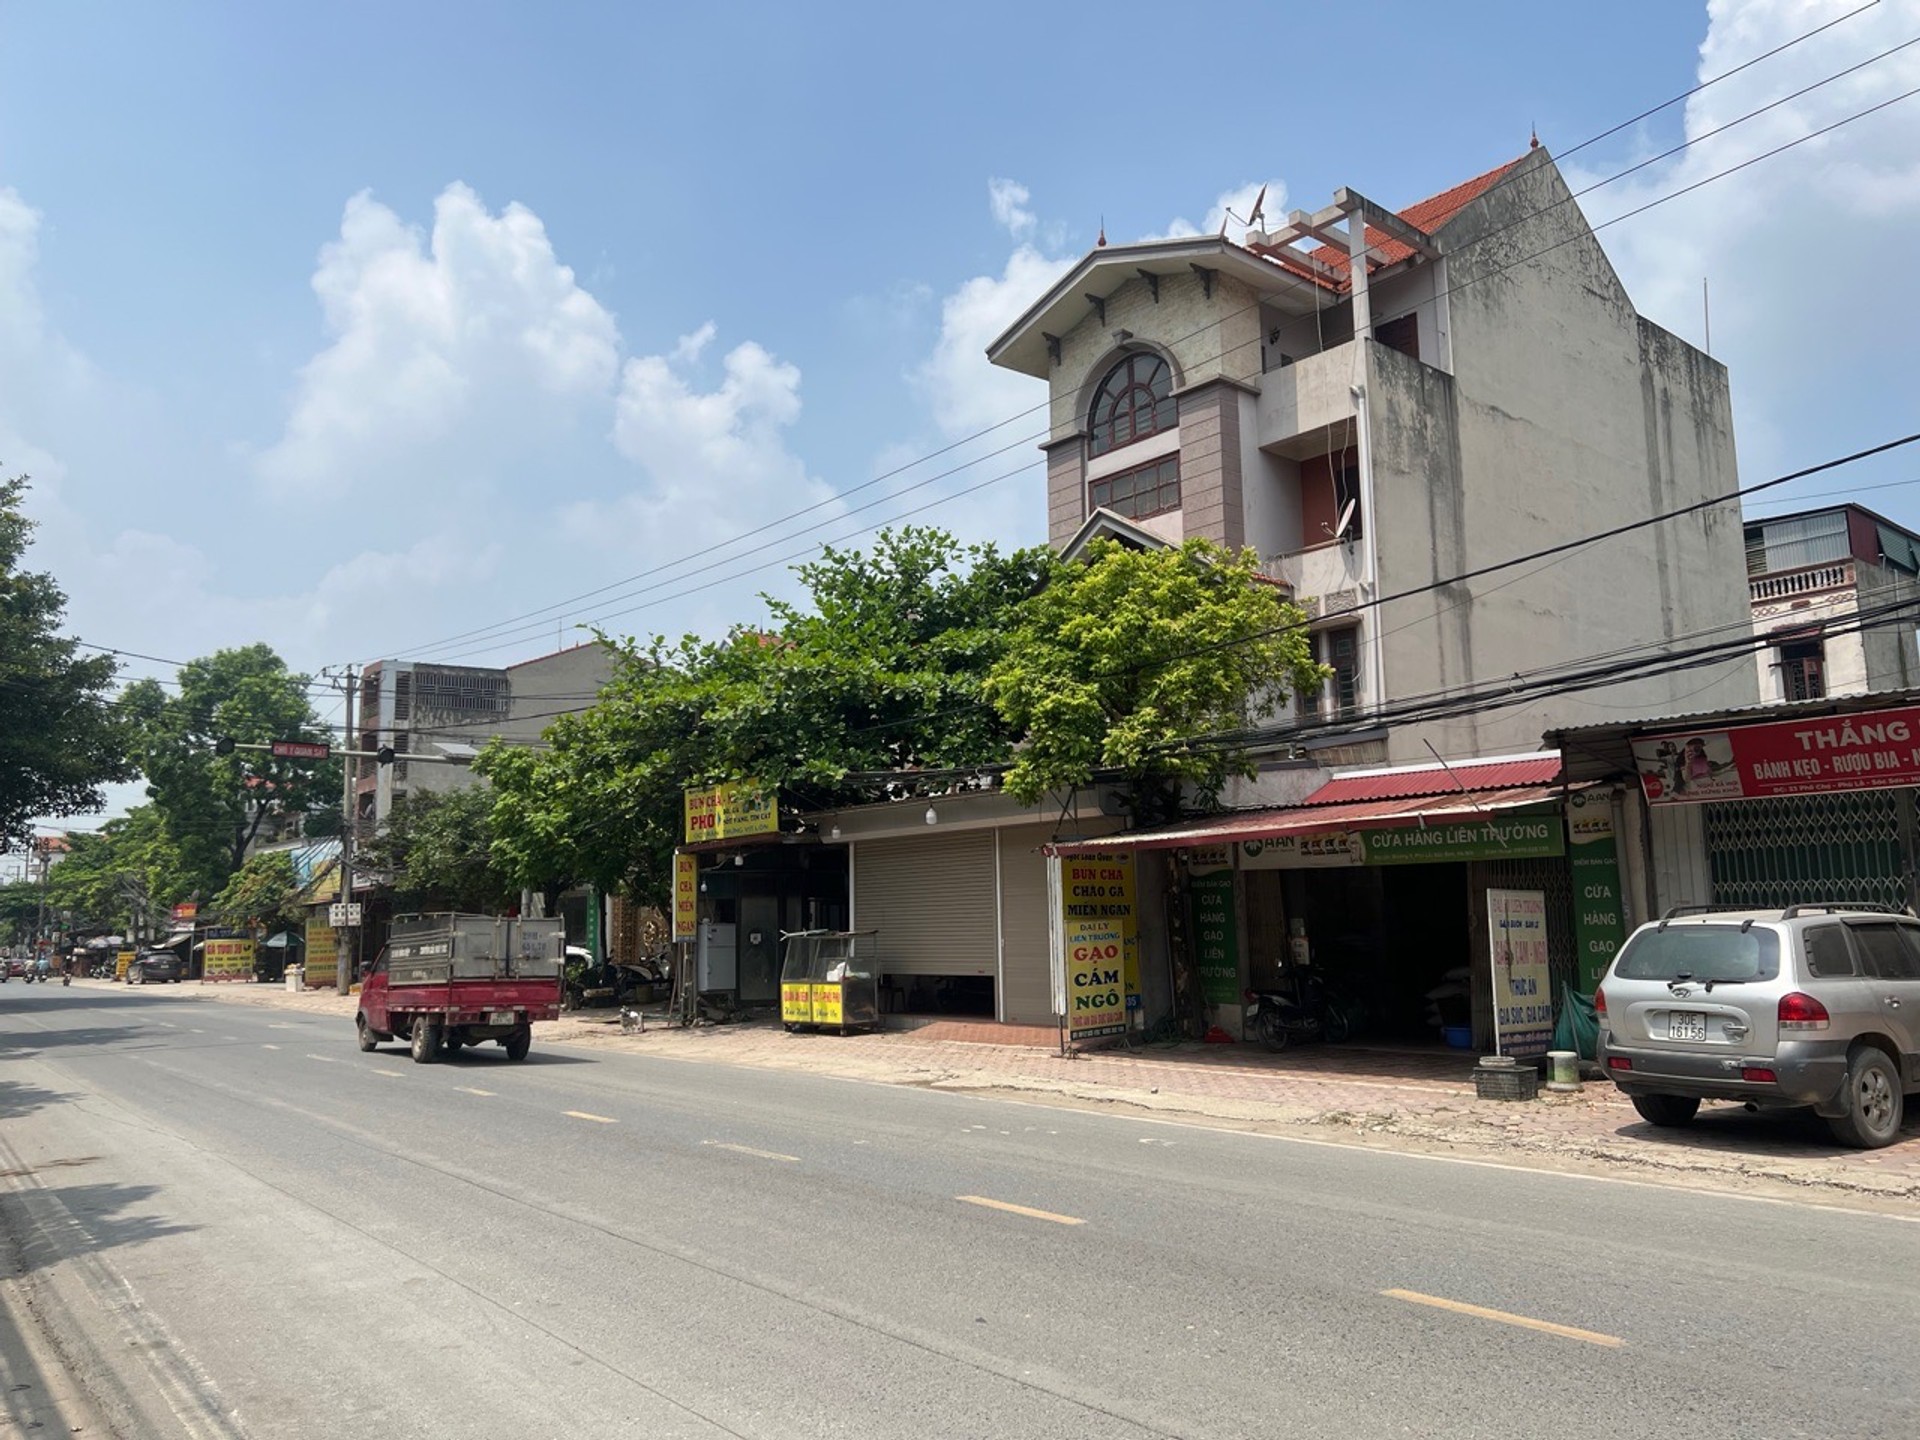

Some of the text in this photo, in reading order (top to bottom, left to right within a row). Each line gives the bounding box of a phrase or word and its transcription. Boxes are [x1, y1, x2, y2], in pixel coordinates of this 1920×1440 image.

[1794, 719, 1911, 751] THẮNG
[1753, 759, 1791, 780] BÁNH
[1793, 757, 1821, 780] KẸO
[1832, 751, 1871, 776] RƯỢU
[1873, 750, 1901, 771] BIA
[1404, 829, 1443, 847] HÀNG
[1446, 827, 1477, 845] LIÊN
[1584, 883, 1613, 899] CỬA
[1583, 910, 1617, 926] HÀNG
[1073, 944, 1119, 965] GẠO
[1589, 940, 1615, 955] GẠO
[1074, 967, 1119, 987] CÁM
[1075, 988, 1120, 1010] NGÔ
[1678, 1013, 1698, 1026] 30E
